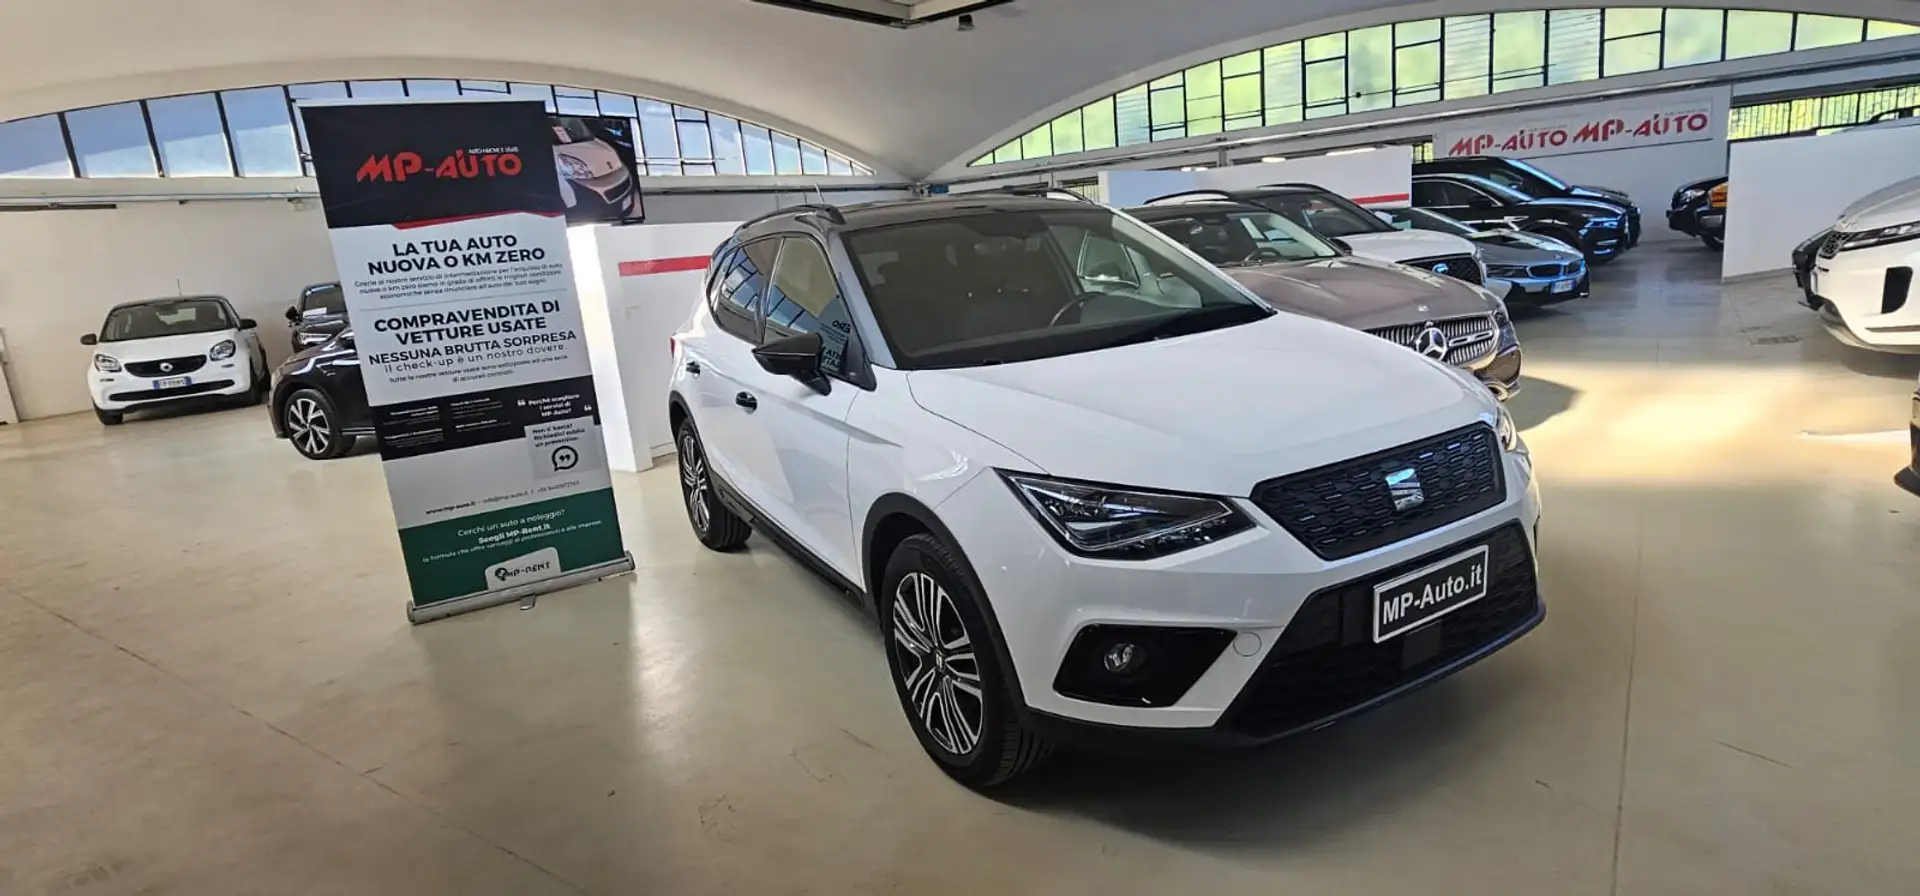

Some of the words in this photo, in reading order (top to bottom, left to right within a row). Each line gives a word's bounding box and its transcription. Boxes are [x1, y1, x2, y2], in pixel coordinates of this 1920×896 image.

[1448, 129, 1568, 157] MP-AUTO
[1573, 113, 1708, 145] MP-AUTO
[356, 149, 522, 183] MP-AUTO
[393, 243, 419, 257] LA
[421, 238, 463, 254] TUA
[466, 234, 518, 251] AUTO
[368, 255, 440, 275] NUOVA
[463, 251, 492, 267] KM
[496, 248, 545, 263] ZERO
[374, 304, 539, 332] COMPRAVENDITA
[542, 300, 560, 313] DI
[395, 324, 485, 345] VETTURE
[488, 316, 547, 335] USATE
[368, 347, 442, 365] NESSUNA
[445, 340, 501, 356] BRUTTA
[503, 330, 577, 349] SORPRESA
[384, 364, 393, 373] il
[396, 356, 454, 373] check-up
[457, 355, 465, 364] è
[468, 354, 483, 362] un
[487, 347, 524, 360] nostro
[457, 525, 485, 536] Cerchi
[526, 508, 565, 523] noleggio?
[478, 532, 505, 544] Scegli
[506, 523, 551, 538] MP-Rent.it
[1383, 564, 1482, 625] MP-Auto.it
